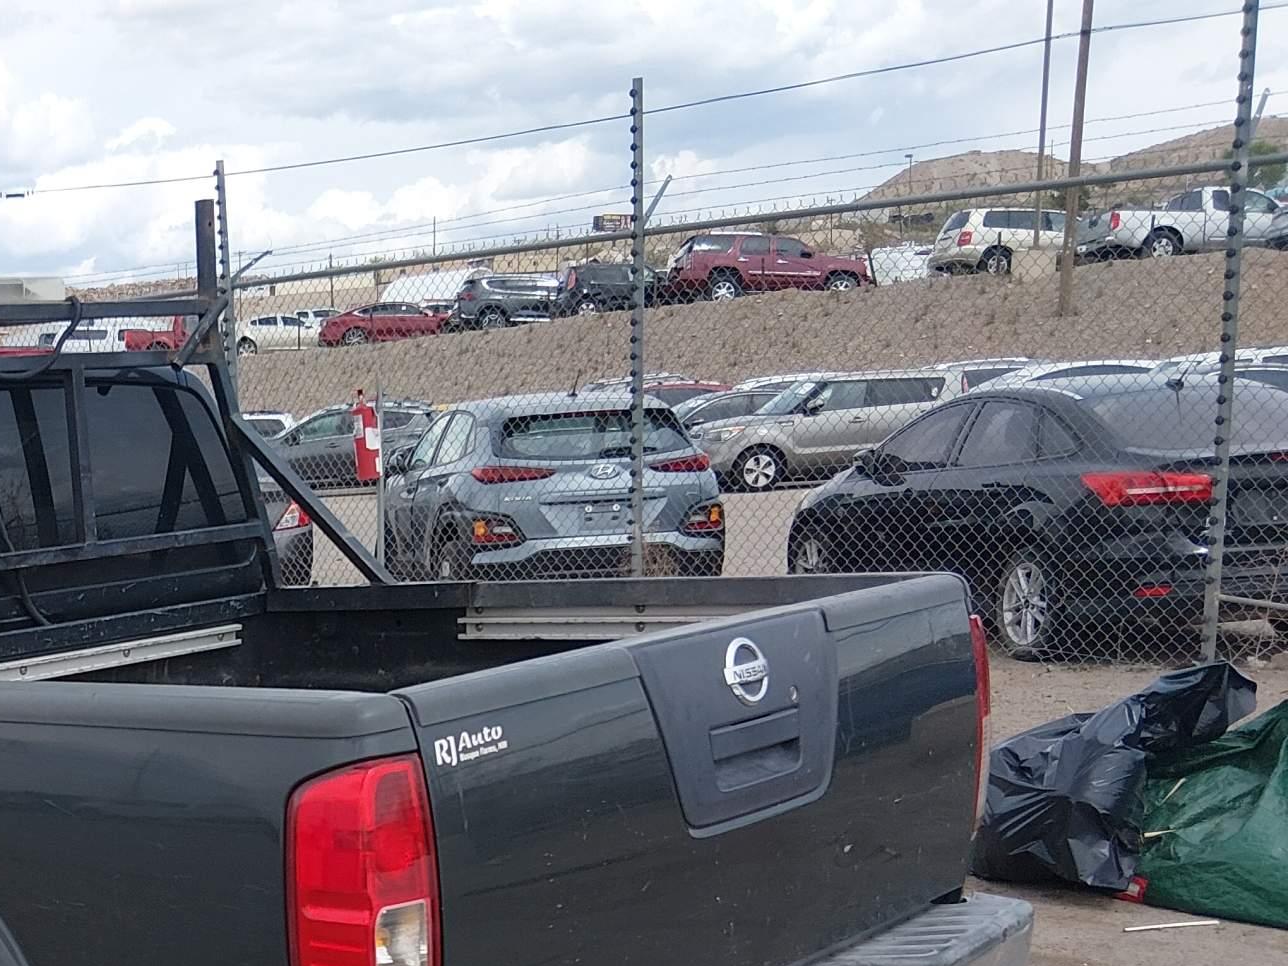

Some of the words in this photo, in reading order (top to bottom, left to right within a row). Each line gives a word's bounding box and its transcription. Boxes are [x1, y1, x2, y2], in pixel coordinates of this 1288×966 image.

[733, 664, 766, 681] NISSAN
[434, 736, 458, 766] RJ
[458, 726, 502, 752] Auto
